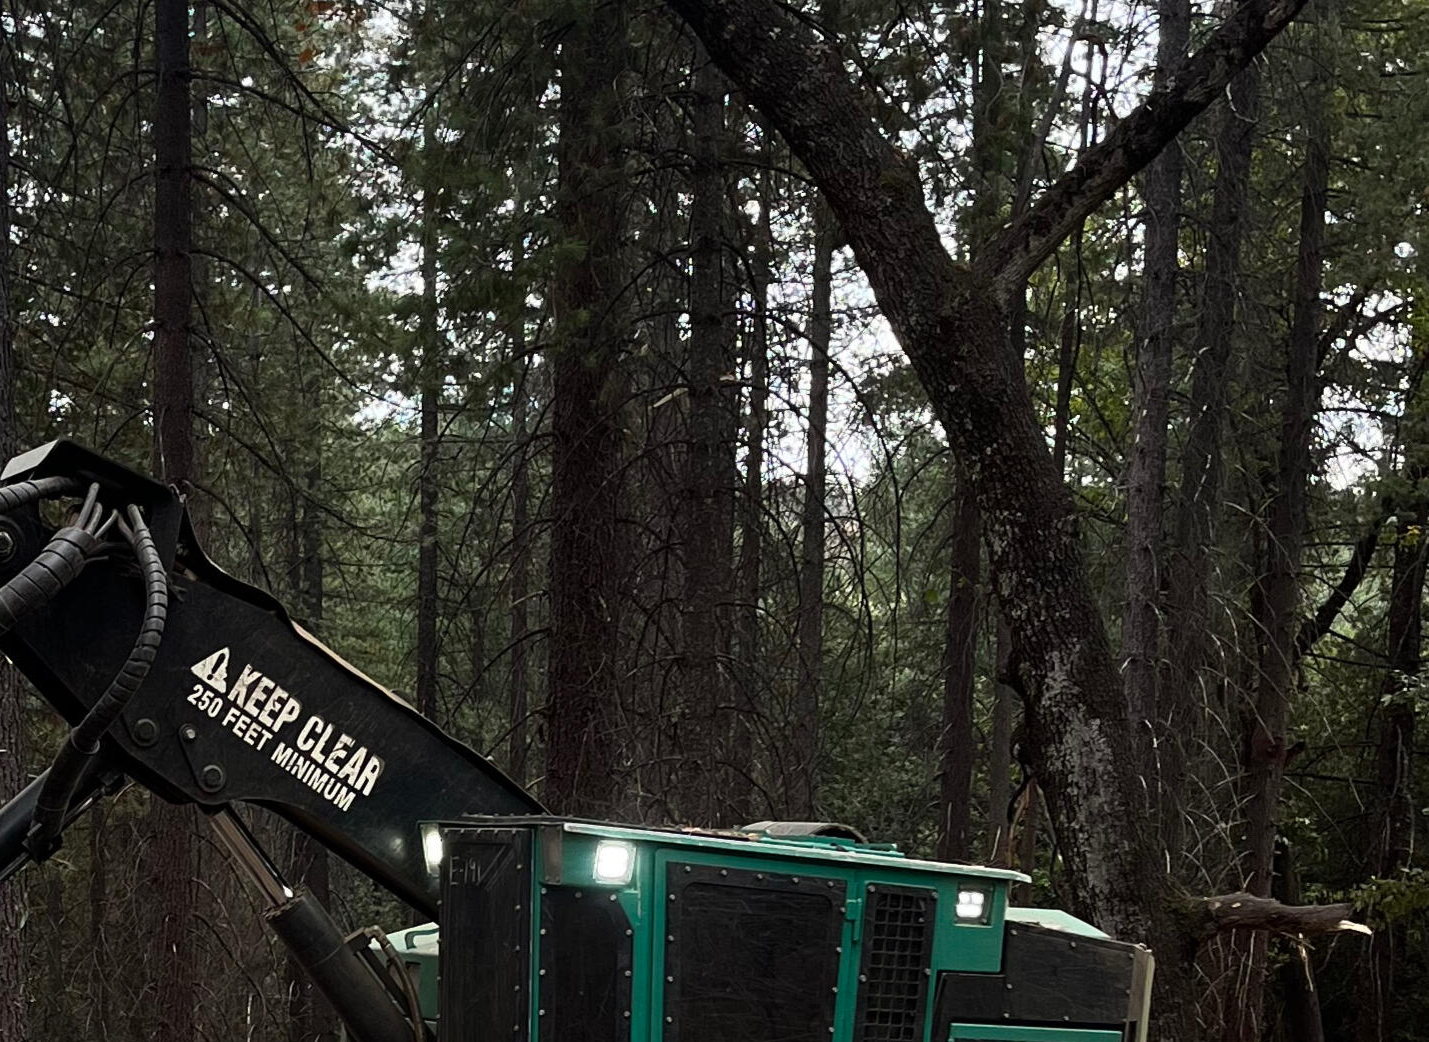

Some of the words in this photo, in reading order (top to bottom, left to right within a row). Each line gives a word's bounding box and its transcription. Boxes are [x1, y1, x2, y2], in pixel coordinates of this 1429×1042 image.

[187, 684, 224, 718] 250
[222, 709, 273, 751] FEET
[271, 742, 357, 812] MINIMUM
[227, 664, 302, 733] KEEP
[296, 715, 384, 797] CLEAR
